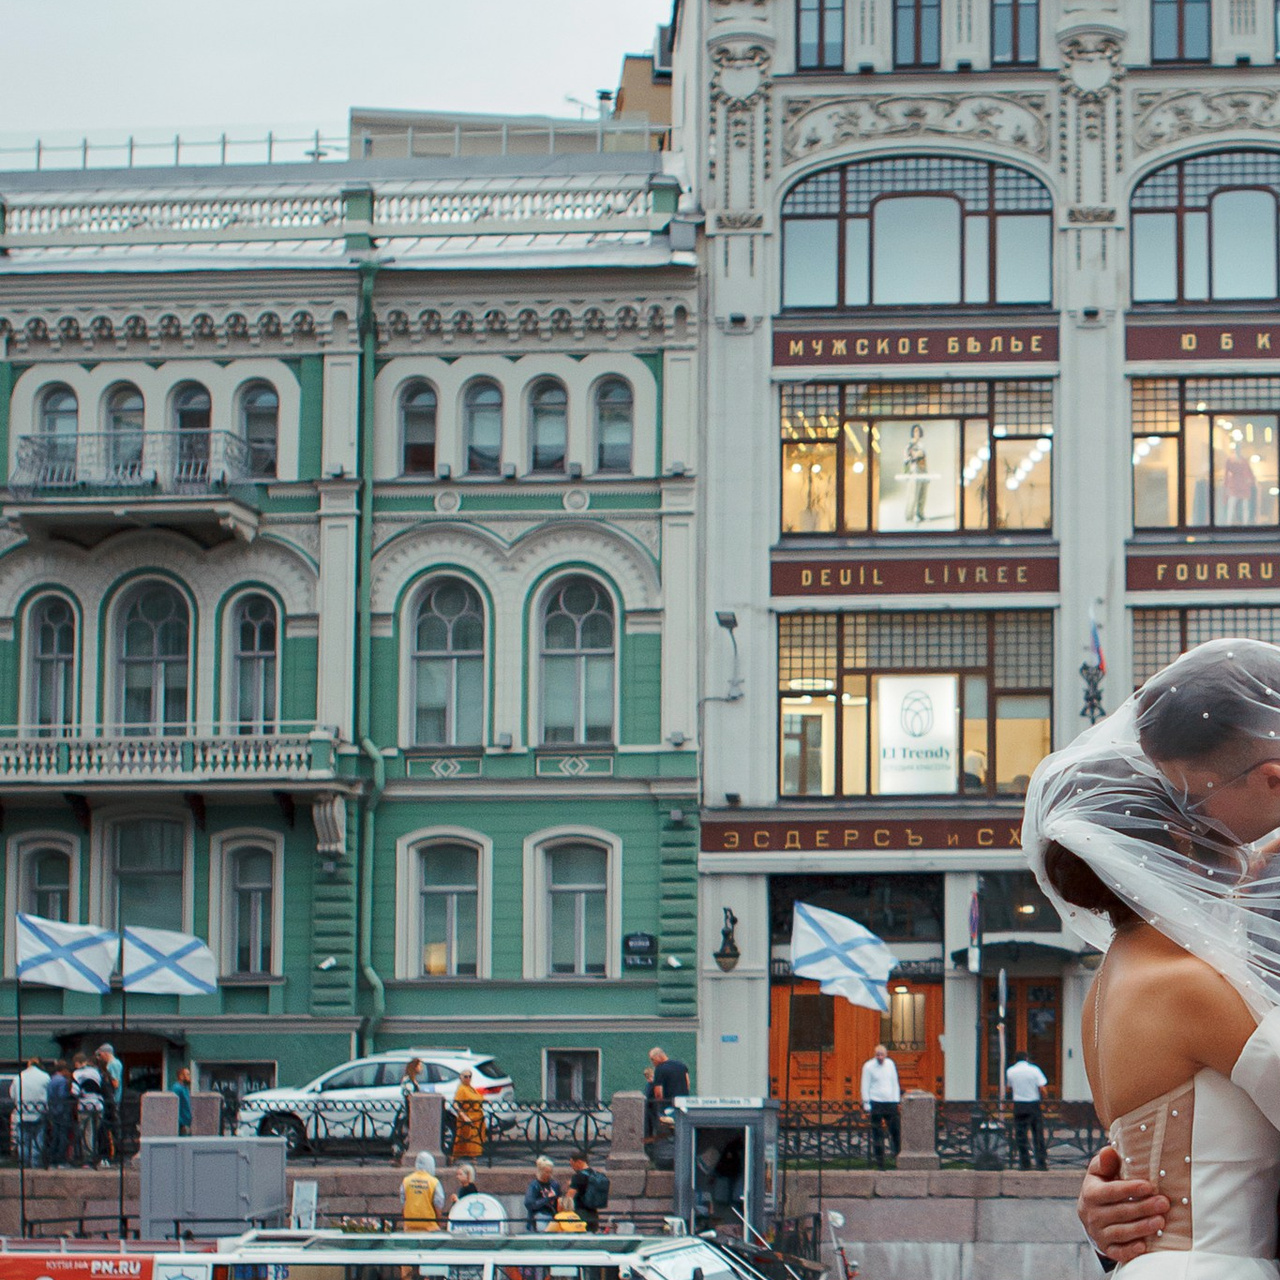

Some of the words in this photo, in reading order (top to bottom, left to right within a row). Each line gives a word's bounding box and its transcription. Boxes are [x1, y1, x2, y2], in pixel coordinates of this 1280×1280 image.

[789, 338, 929, 356] МУЖСКОЕ
[801, 566, 884, 587] DEUIL
[924, 565, 1028, 585] LIVREE
[724, 829, 923, 849] ЭСДЕРСЪ
[91, 1260, 141, 1274] PN.RU
